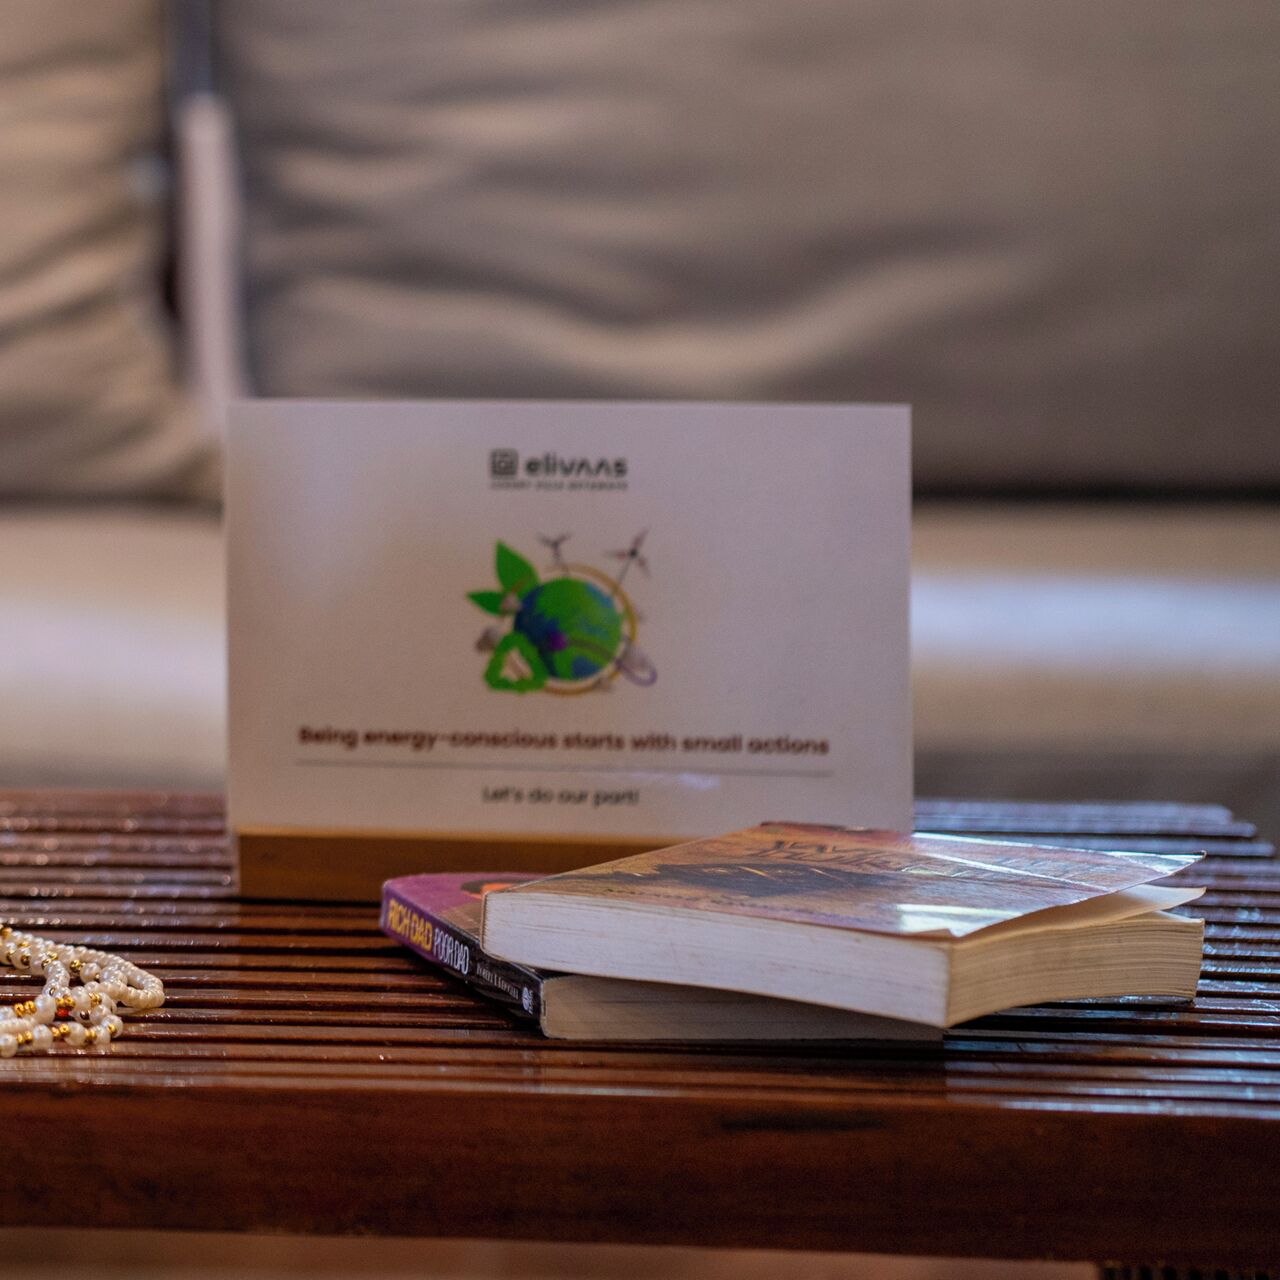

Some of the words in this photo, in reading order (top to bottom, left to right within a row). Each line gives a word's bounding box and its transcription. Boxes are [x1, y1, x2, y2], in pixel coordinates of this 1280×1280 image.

[298, 726, 358, 752] Being
[363, 728, 557, 752] energy-conscious
[561, 732, 625, 751] starts
[630, 732, 677, 751] with
[682, 734, 743, 753] small
[747, 735, 830, 755] actions
[482, 785, 523, 803] Let's
[527, 786, 554, 803] do
[557, 790, 588, 804] our
[387, 899, 410, 937] RICH
[410, 912, 433, 951] DAD
[433, 928, 454, 967] POOR
[454, 940, 470, 975] DAD
